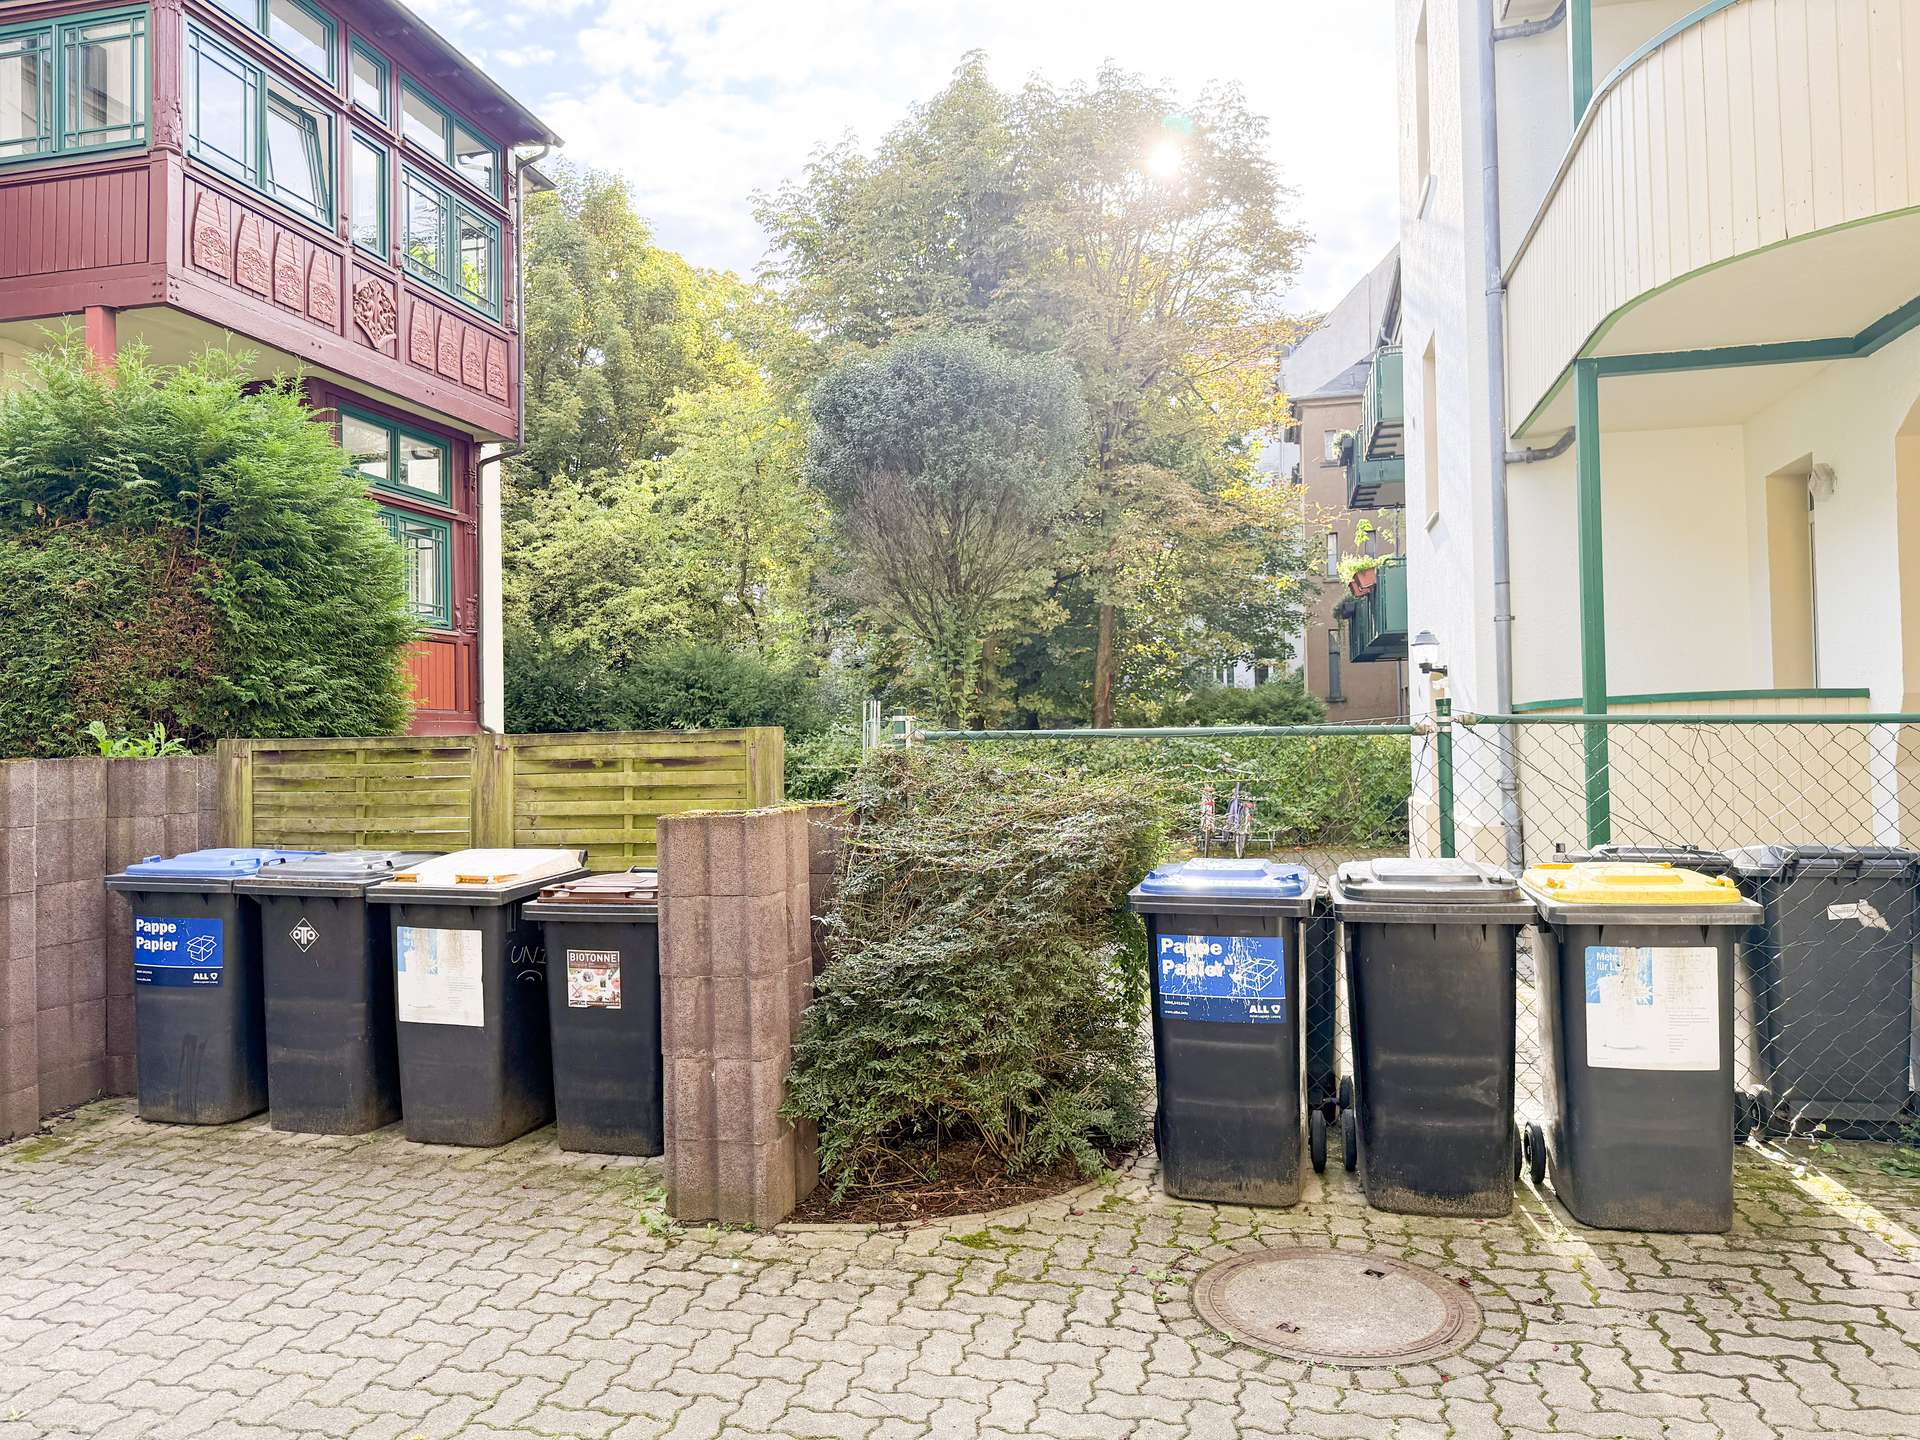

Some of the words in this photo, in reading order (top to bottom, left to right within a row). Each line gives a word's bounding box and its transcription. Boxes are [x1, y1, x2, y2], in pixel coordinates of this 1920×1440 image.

[136, 919, 177, 935] Pappe
[136, 936, 178, 952] Papier
[569, 951, 617, 963] BIOTONNE
[193, 972, 209, 981] ALL
[1249, 1004, 1269, 1014] ALL
